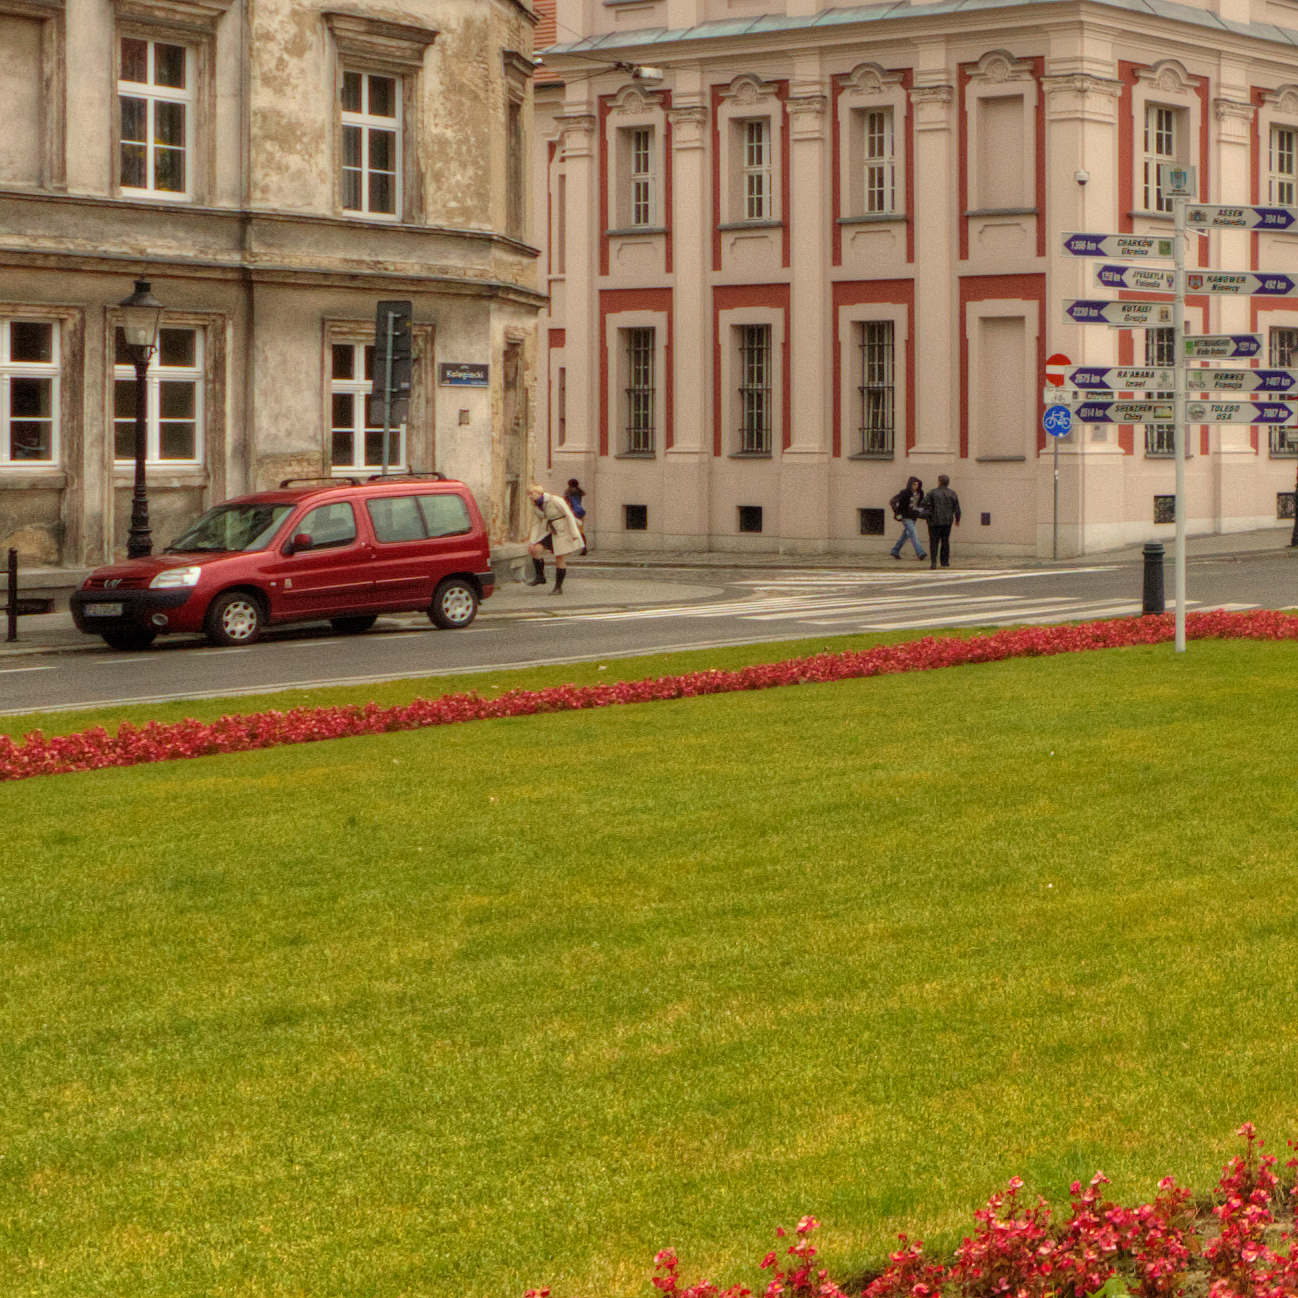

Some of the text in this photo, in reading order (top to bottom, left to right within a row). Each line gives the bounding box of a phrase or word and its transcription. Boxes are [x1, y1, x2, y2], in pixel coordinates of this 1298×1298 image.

[1218, 209, 1243, 217] ASSEN
[1121, 305, 1152, 313] KUTAISI
[1210, 404, 1240, 412] TOLEDO
